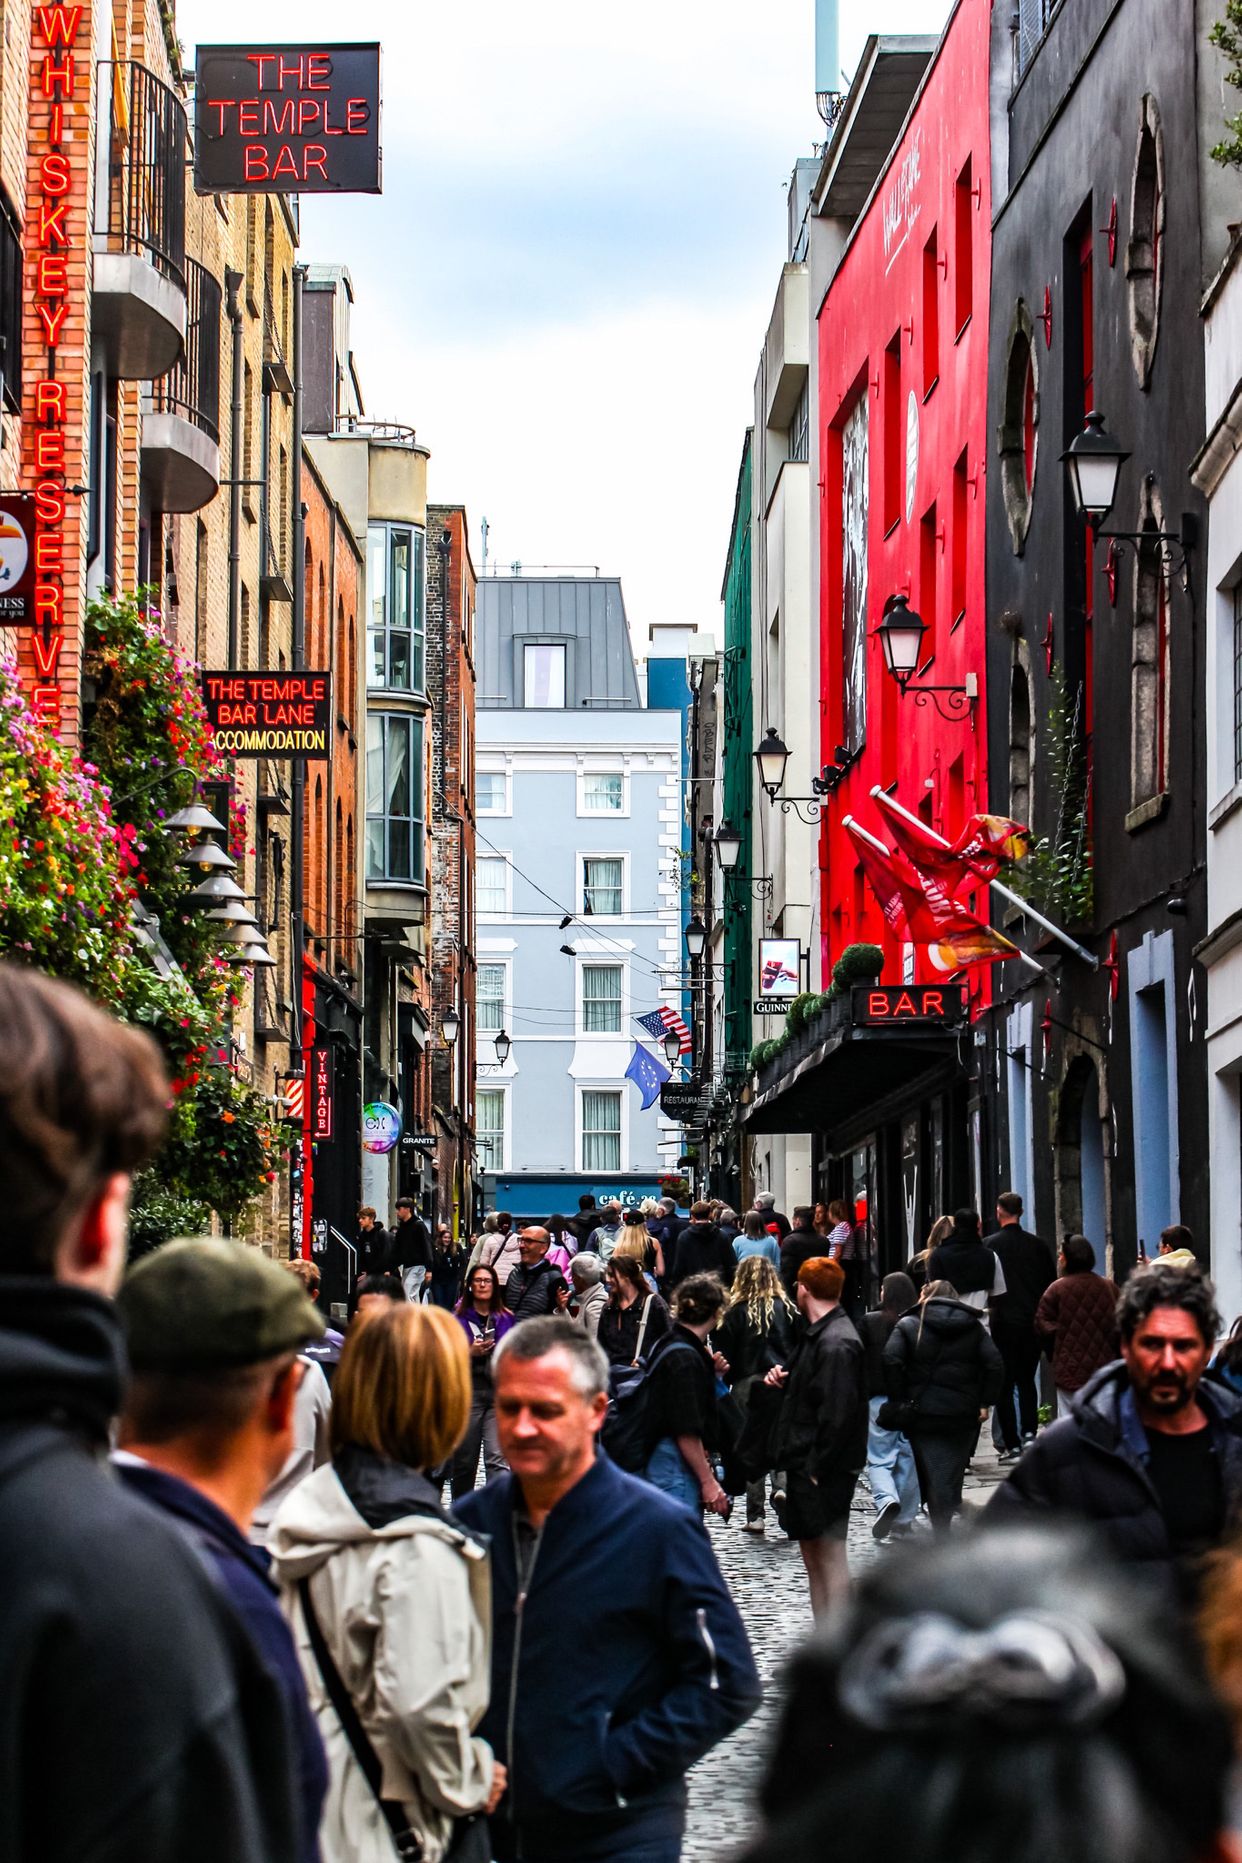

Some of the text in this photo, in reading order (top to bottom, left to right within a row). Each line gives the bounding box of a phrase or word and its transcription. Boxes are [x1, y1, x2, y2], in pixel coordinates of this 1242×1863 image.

[247, 54, 331, 90] THE
[208, 100, 368, 136] TEMPLE
[36, 5, 82, 347] WHISKEY
[244, 145, 328, 181] BAR
[30, 380, 66, 727] RESERVE
[207, 679, 325, 700] THE TEMPLE
[217, 704, 315, 725] BAR LANE
[868, 991, 945, 1016] BAR
[317, 1051, 328, 1129] VINTAGE
